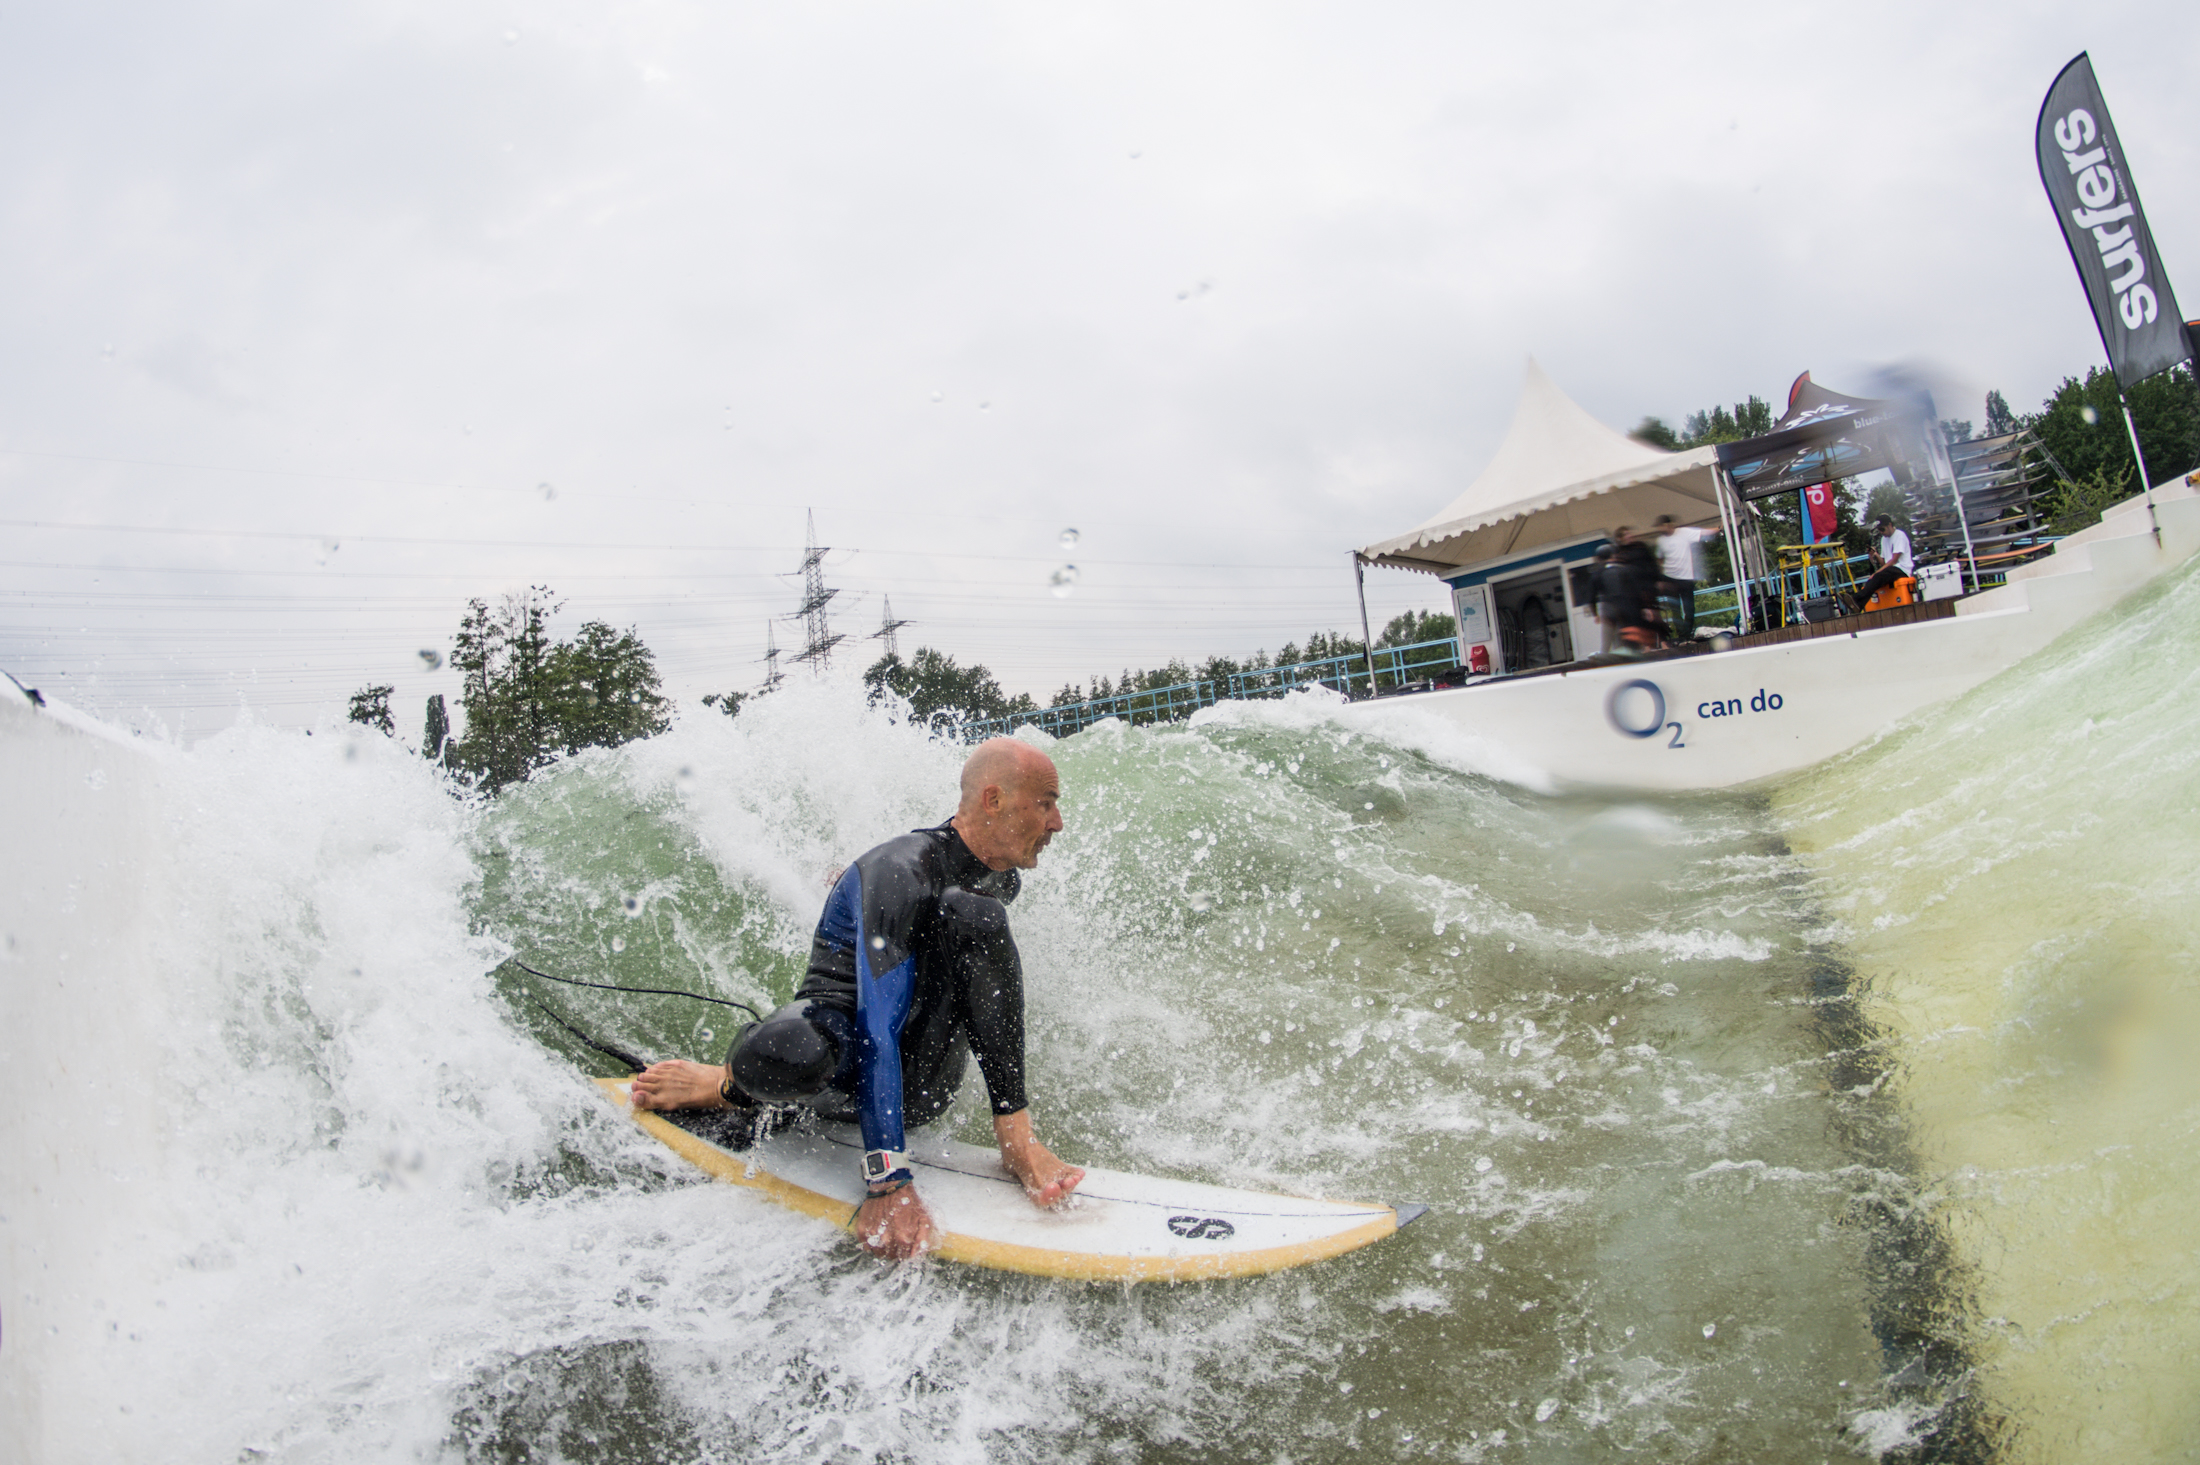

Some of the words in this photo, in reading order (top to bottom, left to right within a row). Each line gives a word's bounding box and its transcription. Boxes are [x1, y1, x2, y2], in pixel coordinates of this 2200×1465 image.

[2054, 108, 2158, 330] surfers
[1697, 698, 1743, 719] can
[1750, 688, 1784, 713] do
